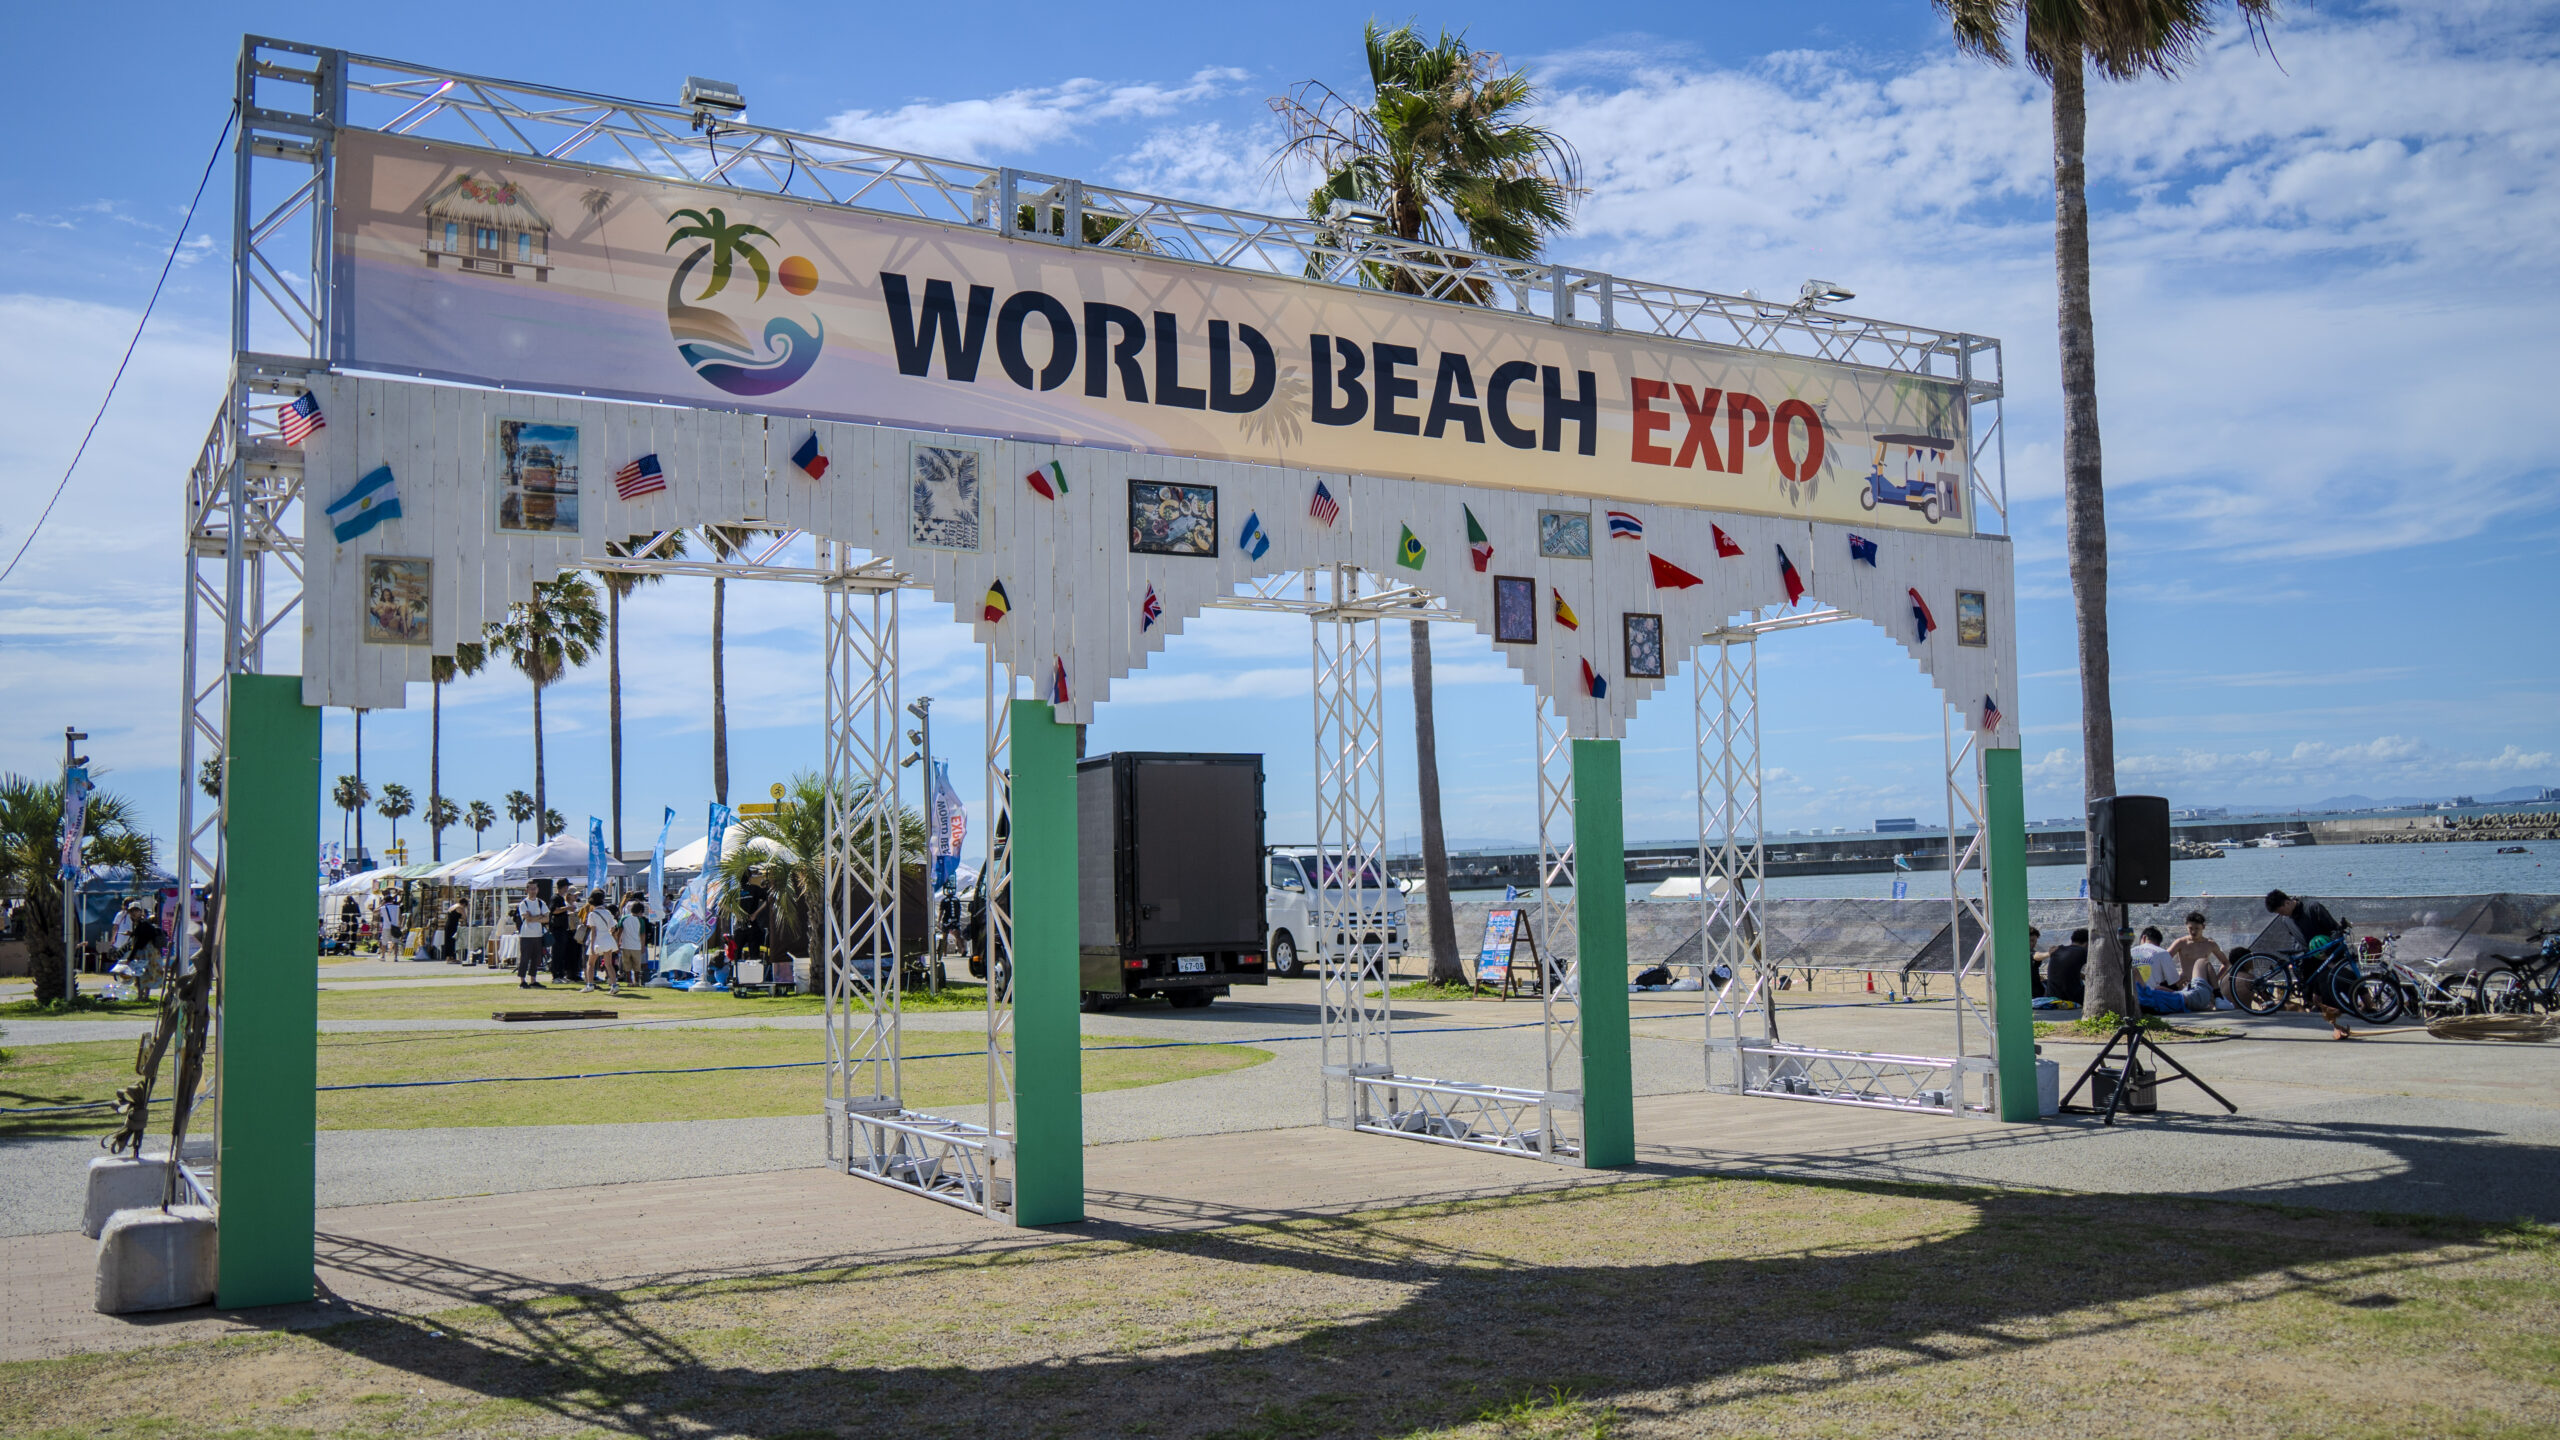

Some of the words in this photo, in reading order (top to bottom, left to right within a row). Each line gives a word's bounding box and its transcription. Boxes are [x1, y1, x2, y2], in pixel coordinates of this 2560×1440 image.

[880, 272, 1276, 413] WORLD
[1310, 334, 1596, 455] BEACH
[1632, 378, 1824, 481] EXPO
[1185, 962, 1204, 971] 67-08
